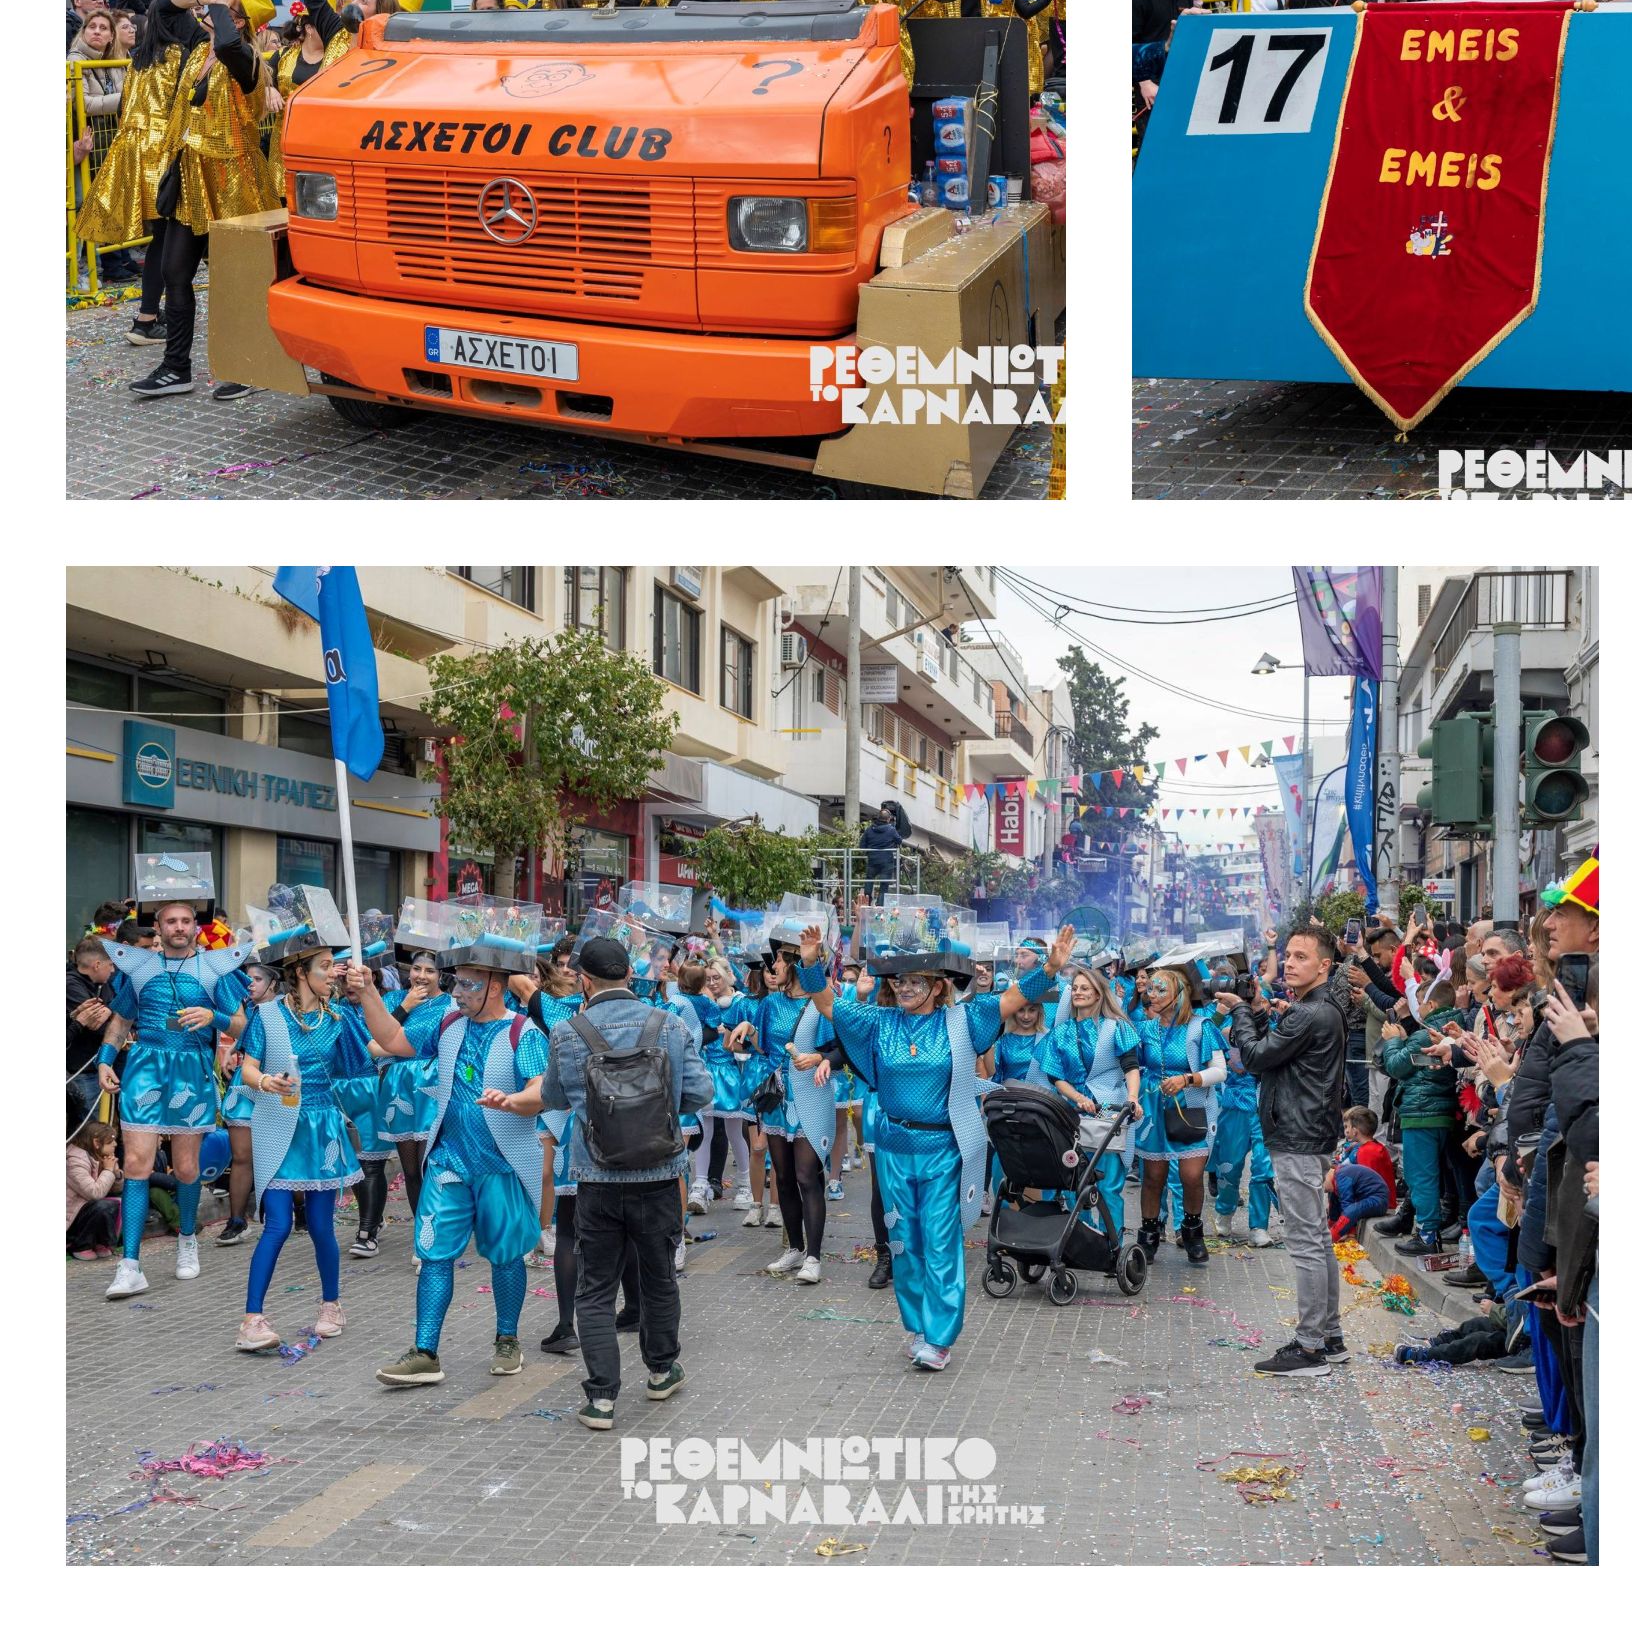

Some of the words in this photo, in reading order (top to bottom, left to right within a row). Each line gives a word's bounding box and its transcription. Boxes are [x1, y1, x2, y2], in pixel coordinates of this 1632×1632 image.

[1400, 27, 1520, 62] EMEIS
[1209, 33, 1326, 124] 17
[1431, 85, 1467, 123] &
[361, 119, 533, 156] ΑΣΧΕΤΟΙ
[548, 123, 673, 161] CLUB
[1379, 148, 1503, 190] EMEIS
[427, 347, 439, 357] GR
[454, 336, 557, 374] ΑΣΧΕΤΟΙ
[175, 757, 258, 801] ΕΘΝΙΚΗ
[260, 772, 337, 812] ΤΡΑΠΕΖ
[461, 882, 479, 895] MEGA
